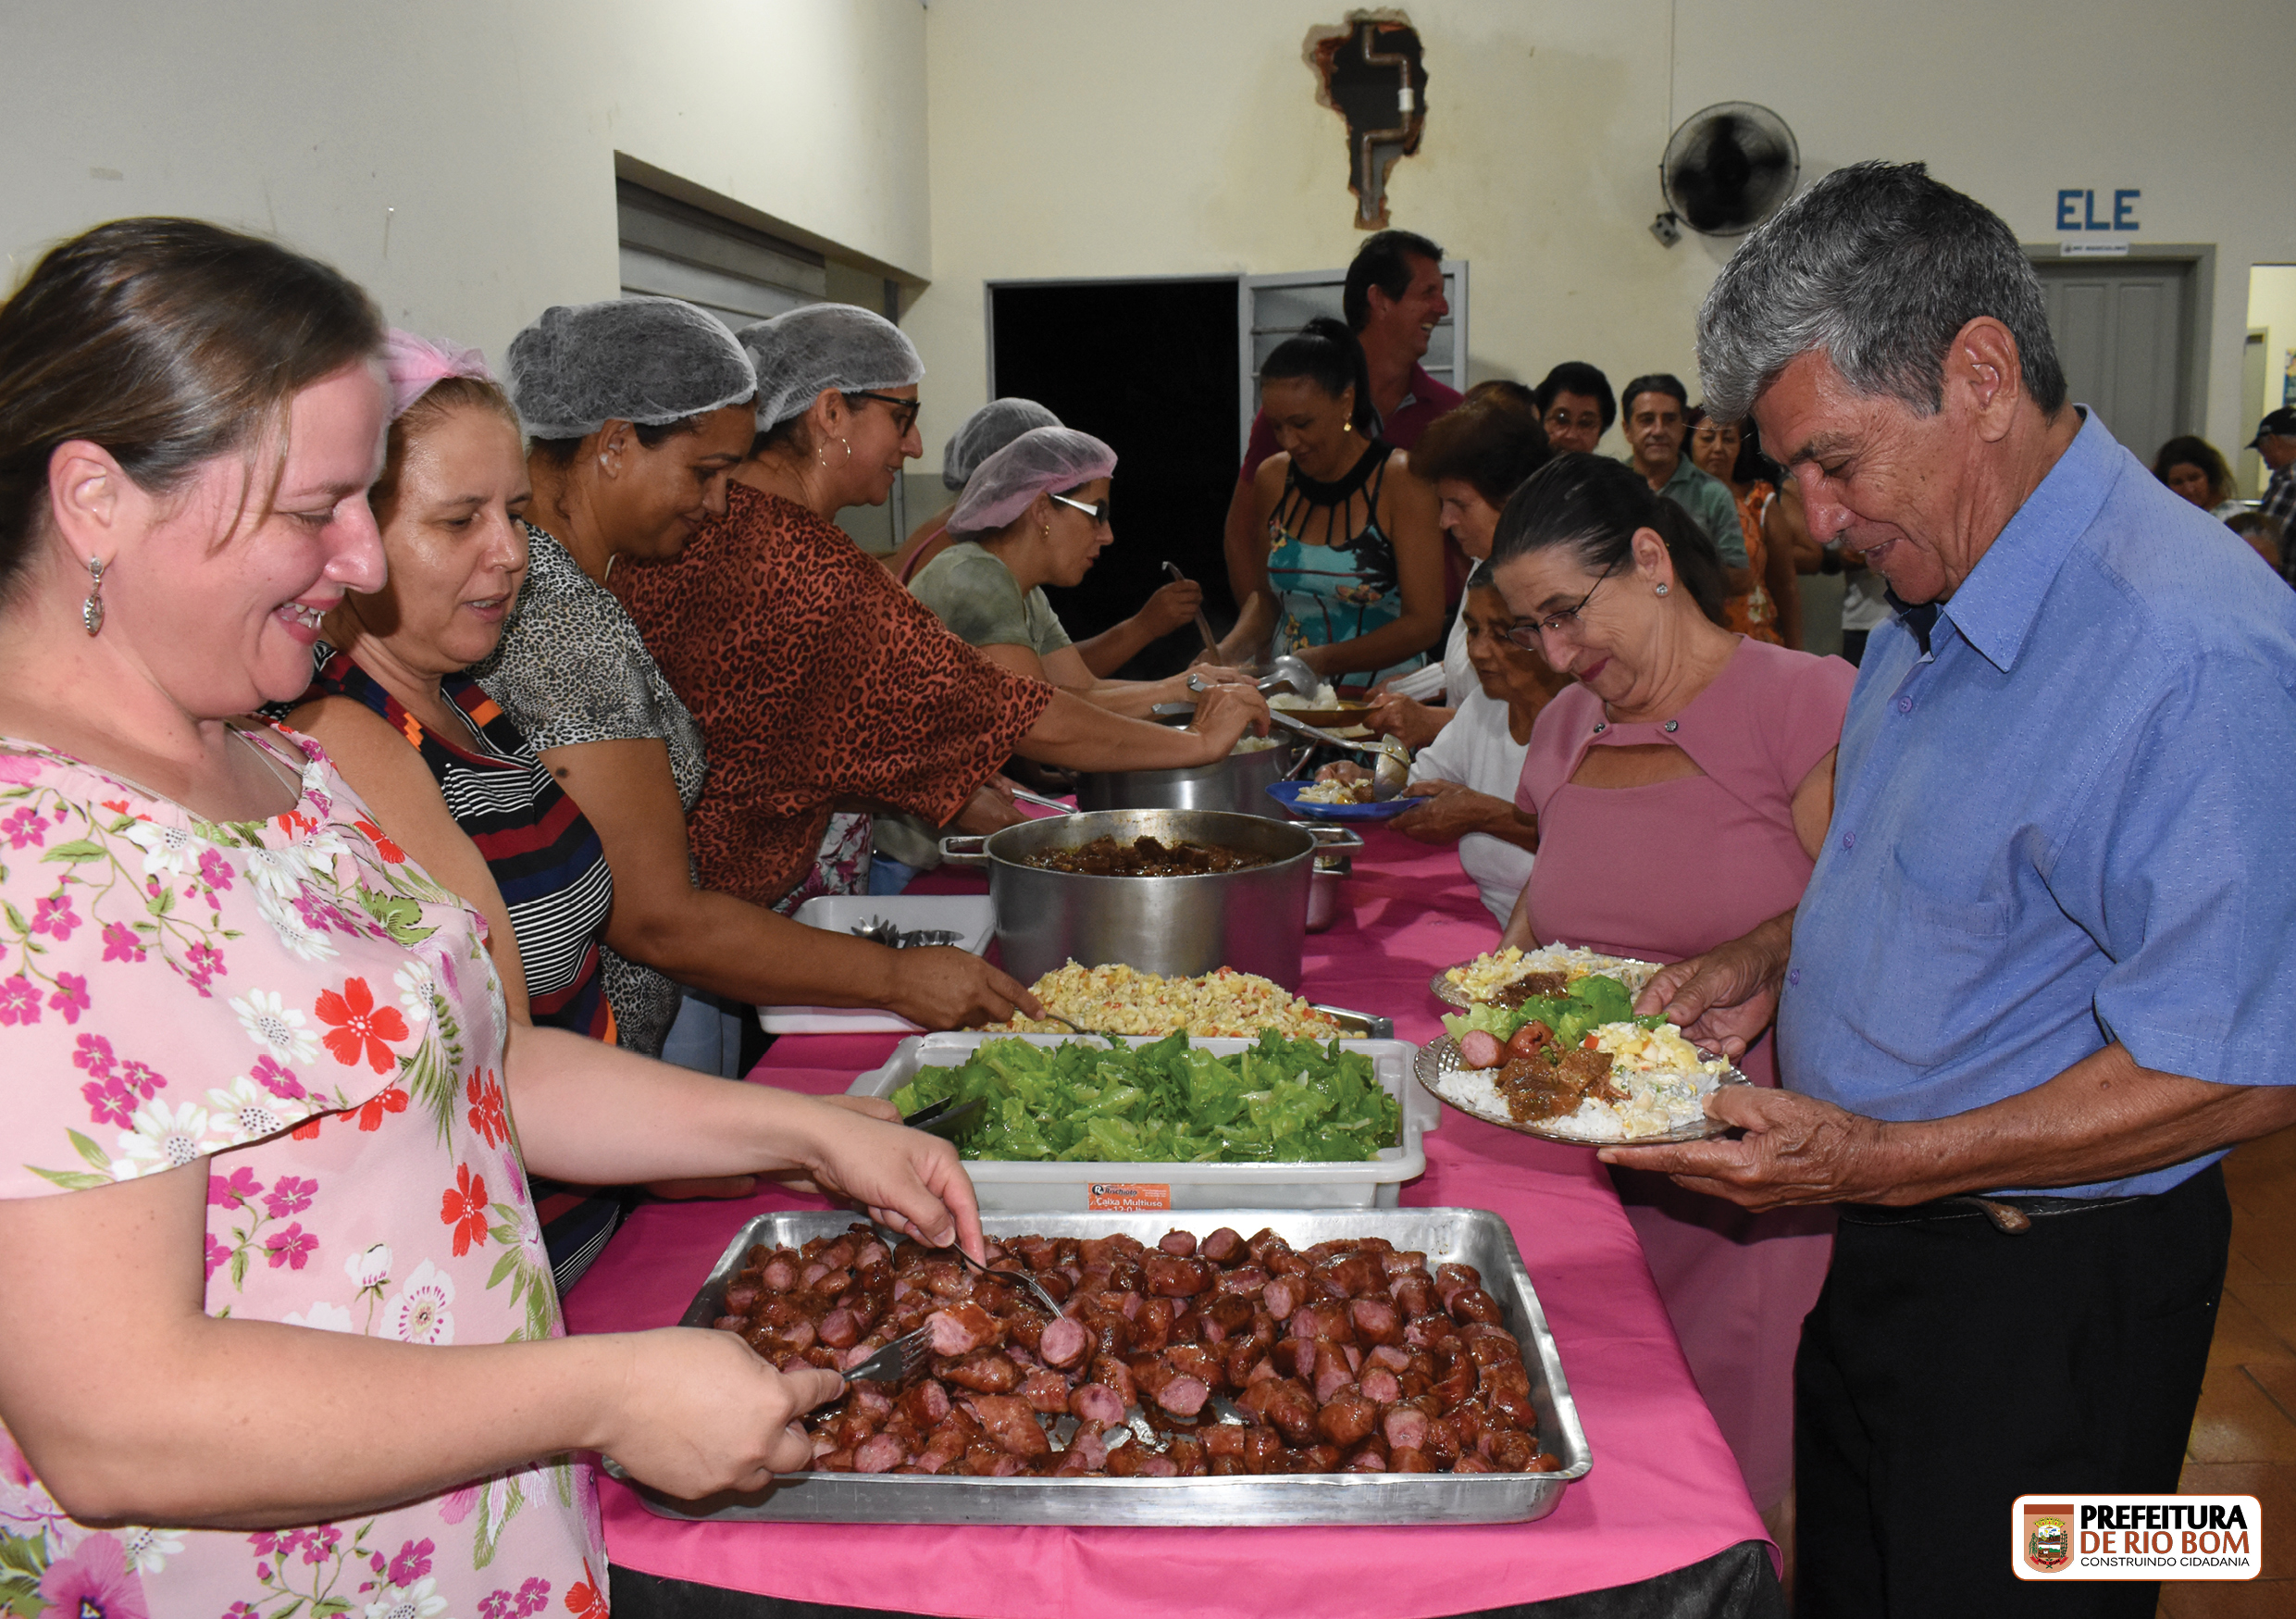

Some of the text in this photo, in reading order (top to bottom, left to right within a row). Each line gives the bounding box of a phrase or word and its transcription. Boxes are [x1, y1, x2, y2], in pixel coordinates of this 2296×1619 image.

[2056, 189, 2141, 230] ELE
[1097, 1197, 1163, 1207] Caixa Multiuso
